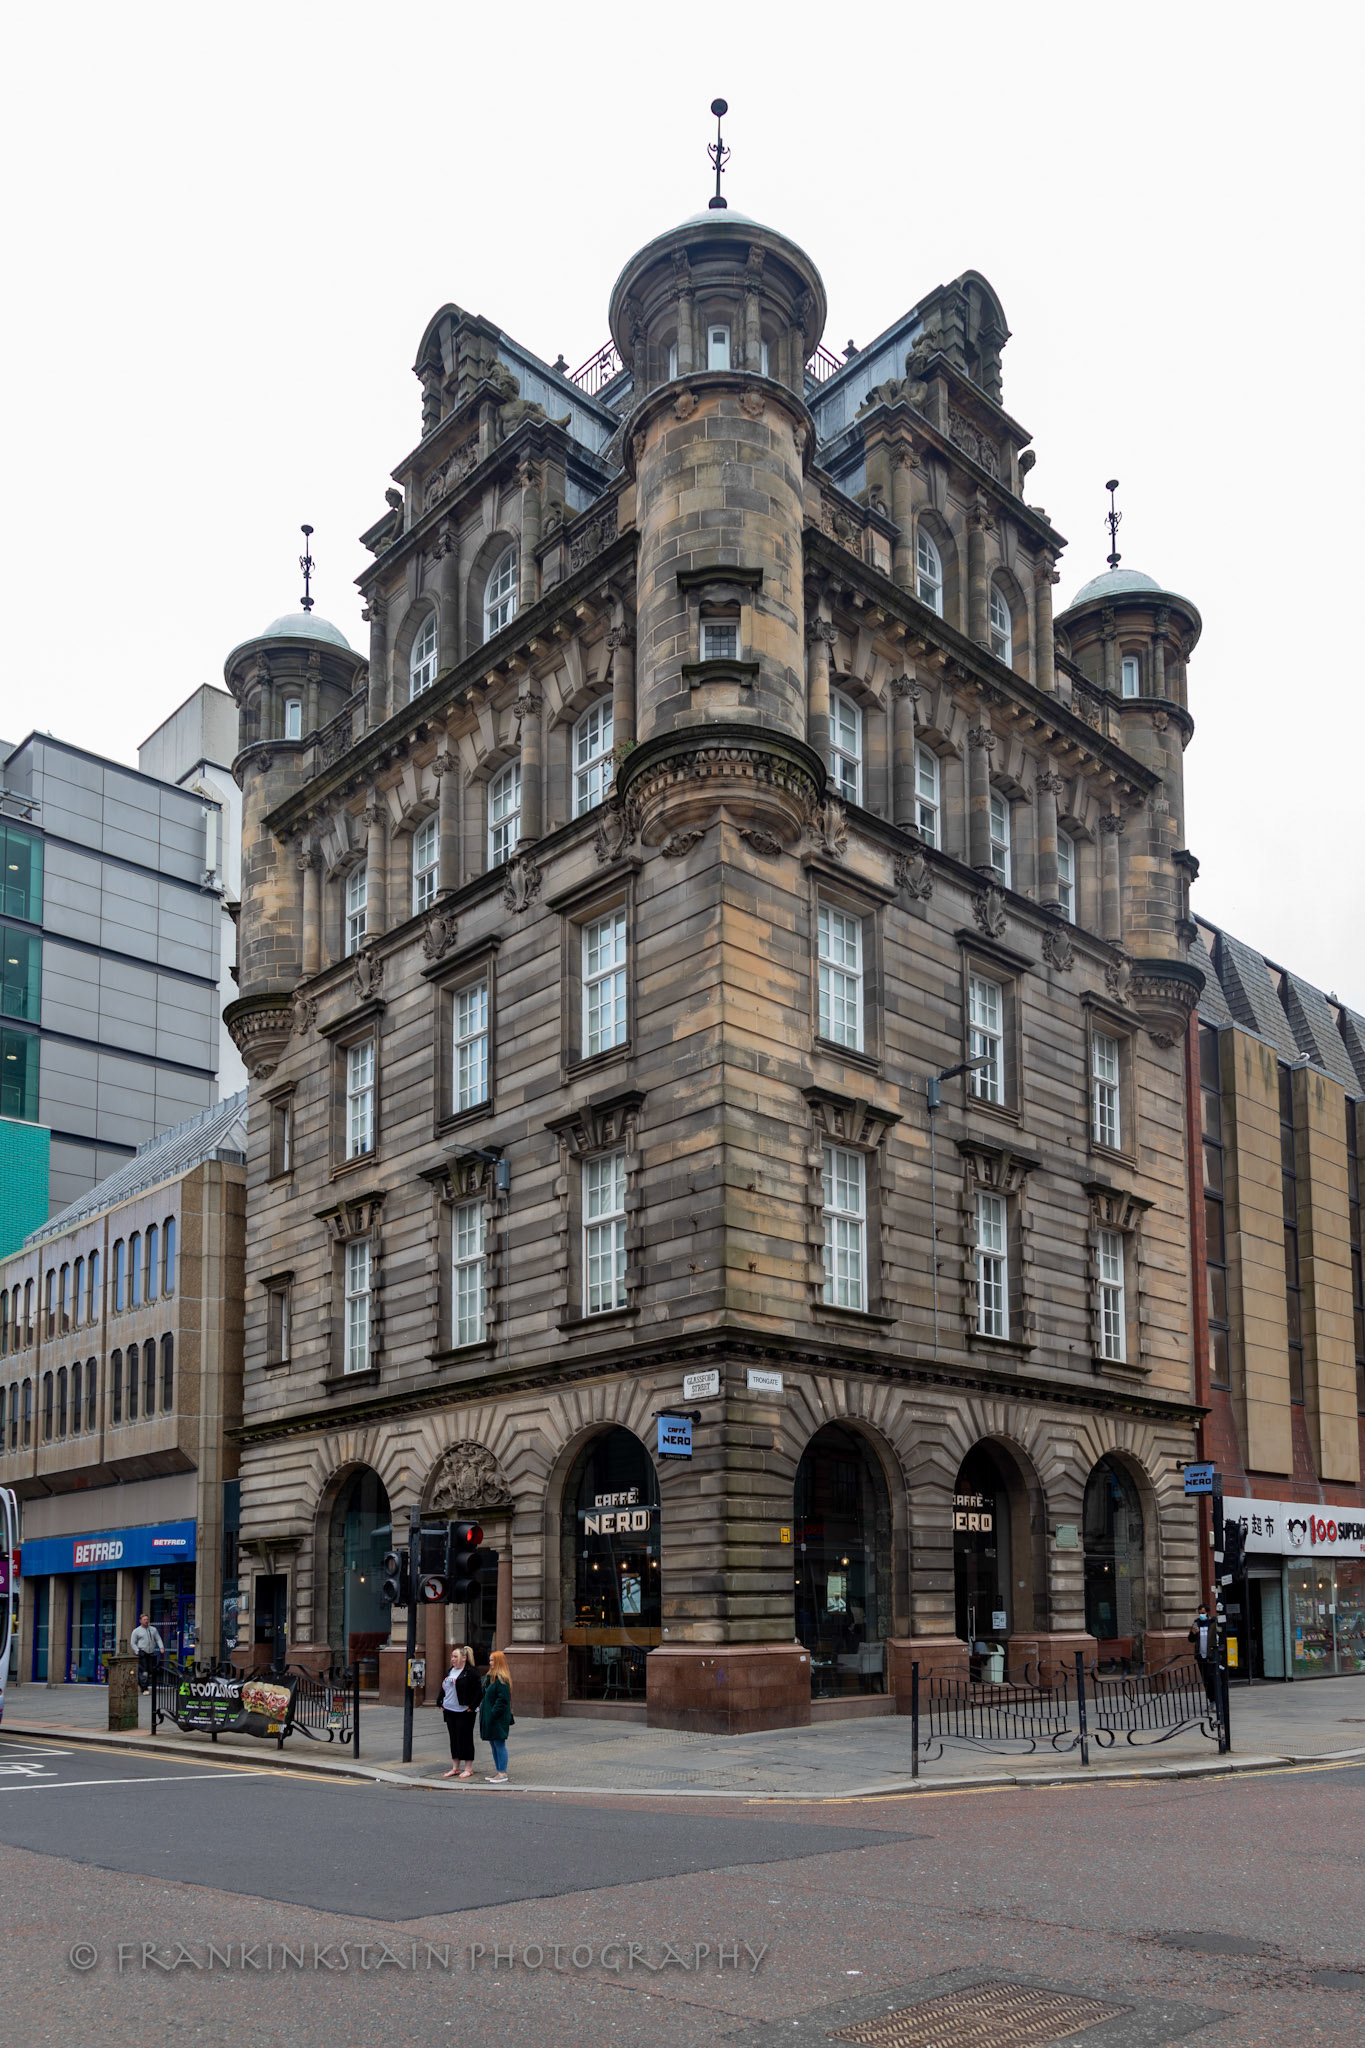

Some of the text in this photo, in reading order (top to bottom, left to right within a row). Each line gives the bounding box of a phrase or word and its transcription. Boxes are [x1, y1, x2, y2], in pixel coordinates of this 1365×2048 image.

[687, 1373, 716, 1385] GLASSFORD
[752, 1376, 779, 1386] TRONGATE
[691, 1383, 711, 1393] STREET
[662, 1435, 691, 1446] NERO
[1185, 1478, 1212, 1486] NERO
[584, 1510, 650, 1536] NERO
[953, 1512, 993, 1532] ERO
[1309, 1514, 1338, 1544] 100
[75, 1541, 124, 1564] BETFRED
[179, 1682, 240, 1699] £5 FOOTLONG
